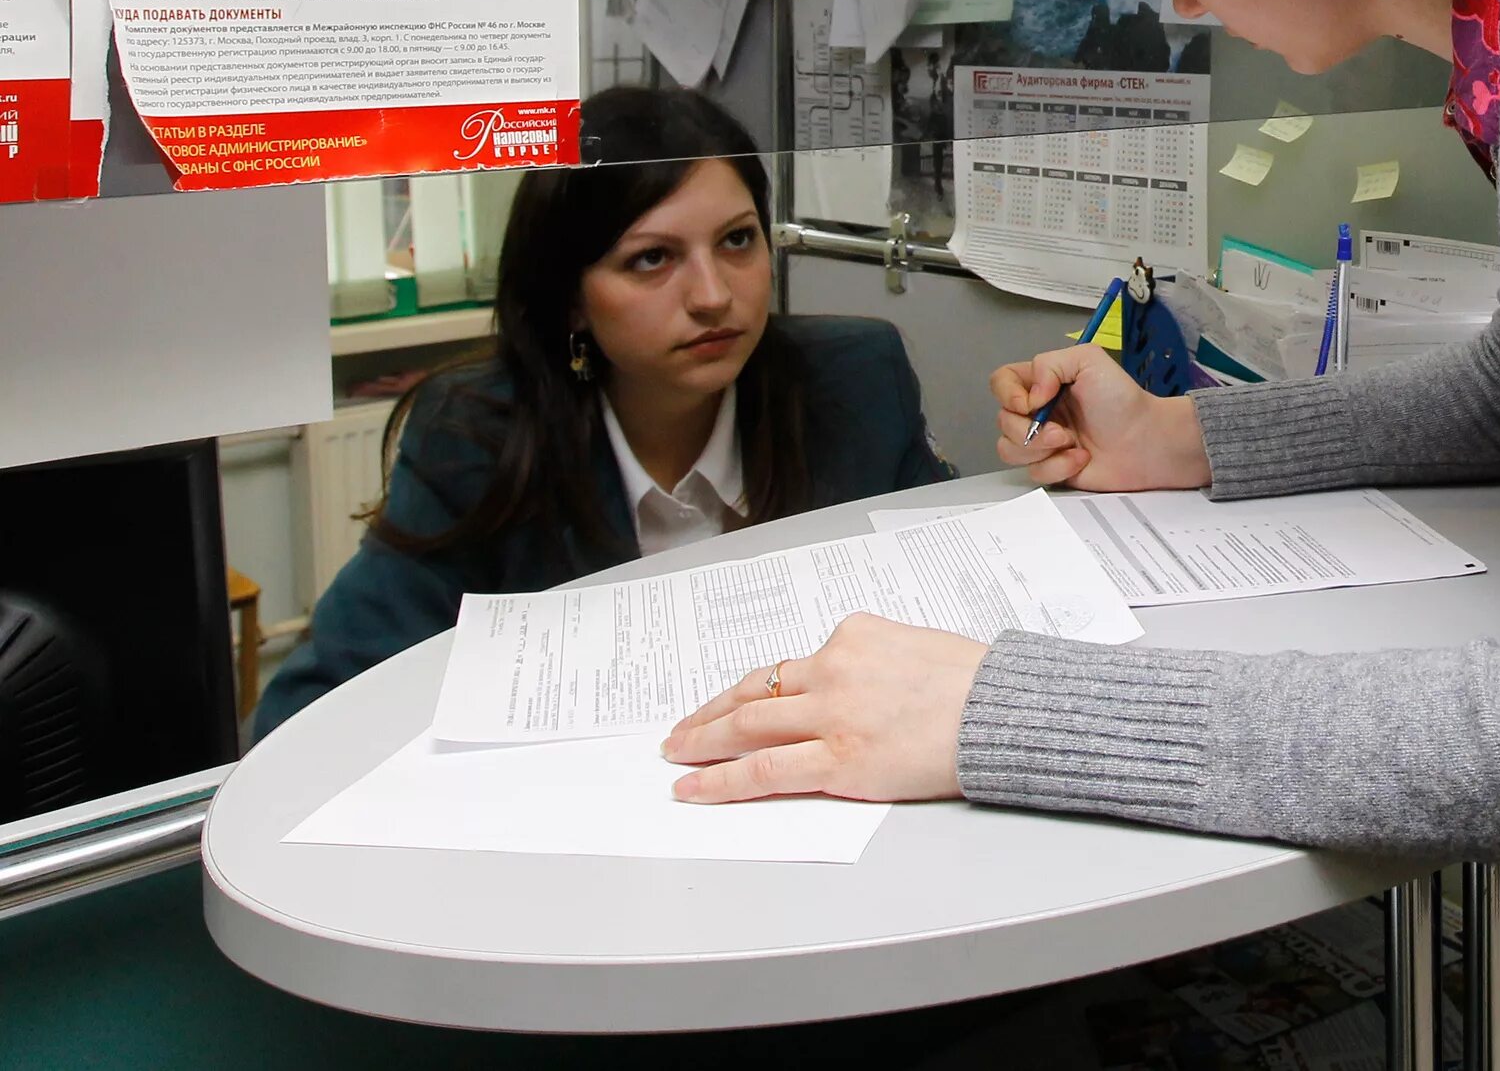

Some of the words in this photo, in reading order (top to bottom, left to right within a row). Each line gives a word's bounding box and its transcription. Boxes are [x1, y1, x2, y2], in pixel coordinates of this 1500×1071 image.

[143, 9, 205, 21] ПОДАВАТЬ
[209, 8, 280, 21] ДОКУМЕНТЫ
[312, 23, 377, 32] Межрайонную
[1016, 73, 1077, 89] Аудиторская
[1079, 75, 1114, 90] фирма
[198, 126, 206, 137] В
[211, 124, 265, 137] РАЗДЕЛЕ
[209, 135, 367, 156] АДМИНИСТРИРОВАНИЕ»
[221, 161, 230, 172] С
[232, 159, 263, 172] ФНС
[265, 156, 320, 169] РОССИИ
